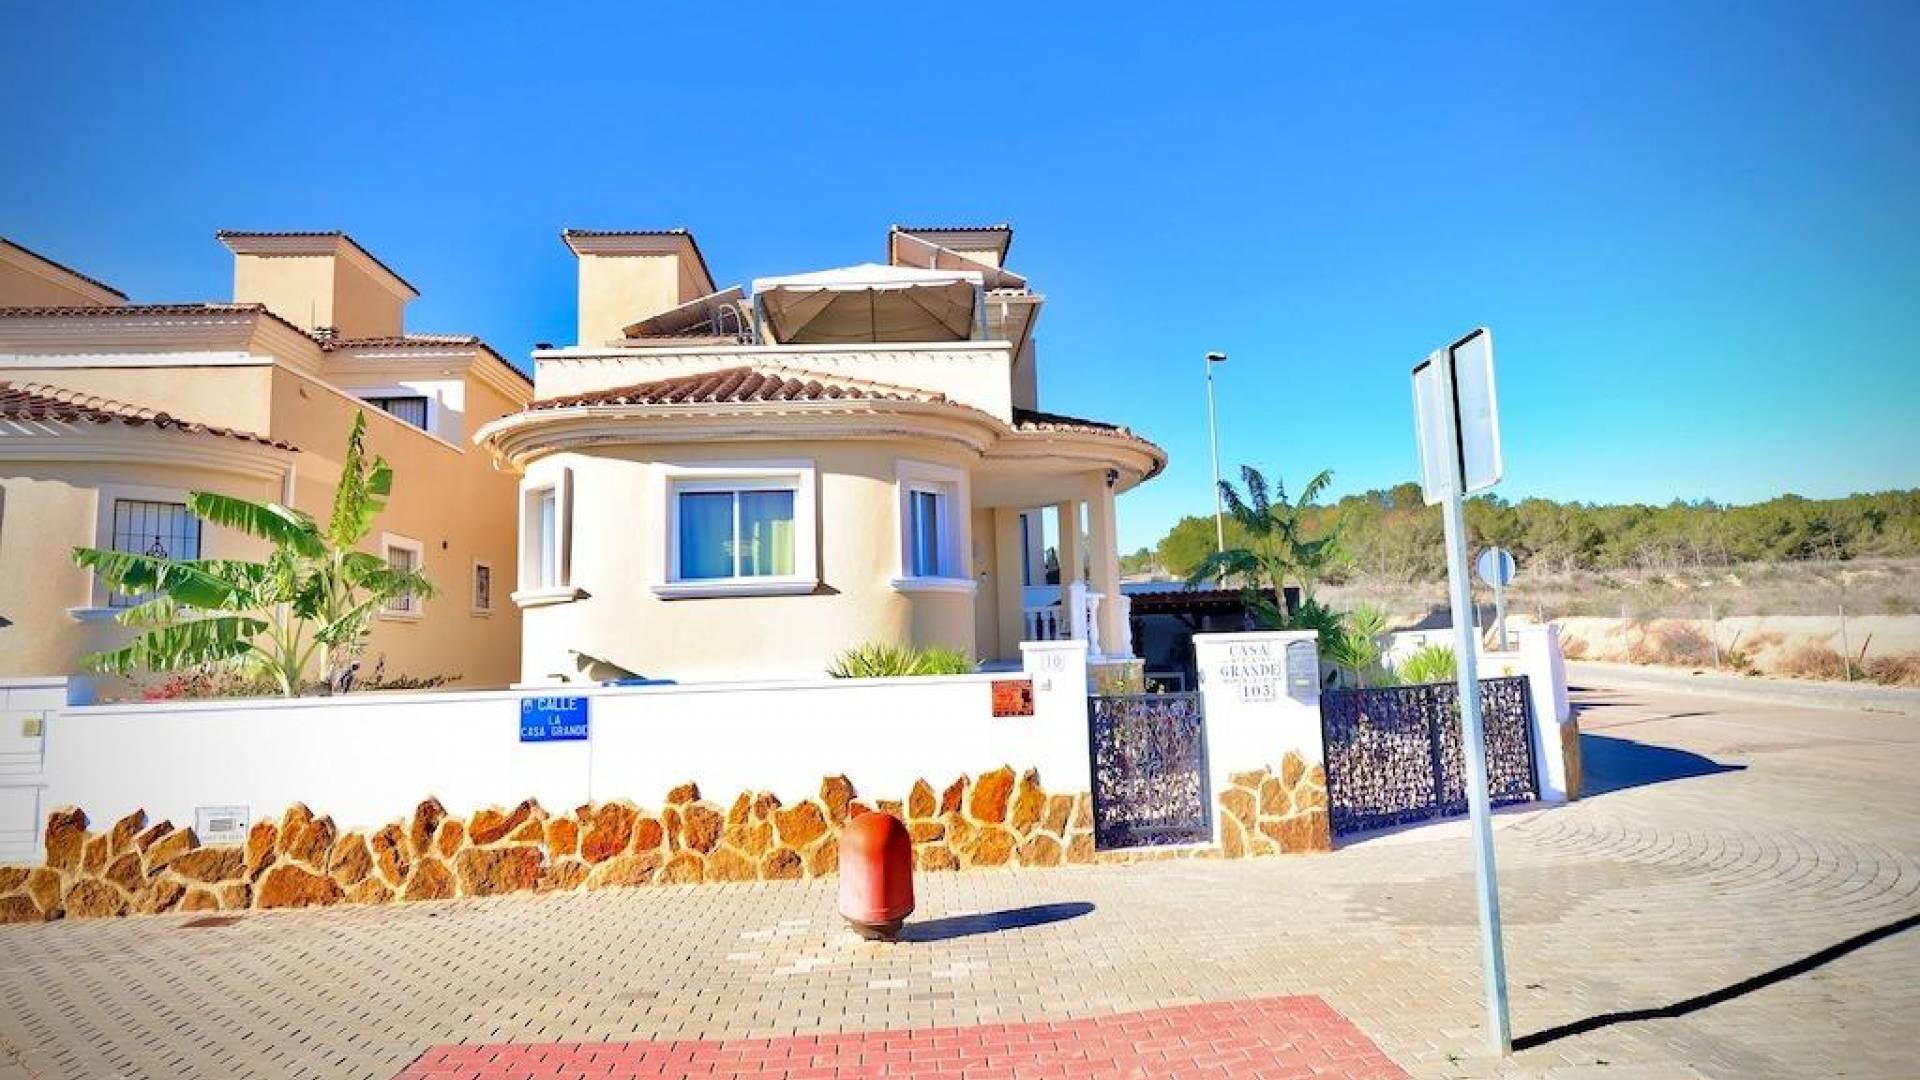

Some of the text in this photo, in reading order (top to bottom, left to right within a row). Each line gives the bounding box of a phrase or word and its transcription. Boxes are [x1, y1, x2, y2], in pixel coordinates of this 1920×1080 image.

[1229, 644, 1268, 656] CASA
[1220, 663, 1279, 678] GRANDE
[538, 697, 577, 711] CALLE
[549, 714, 561, 725] LA
[521, 726, 547, 737] CASA
[550, 725, 588, 736] GRANDE
